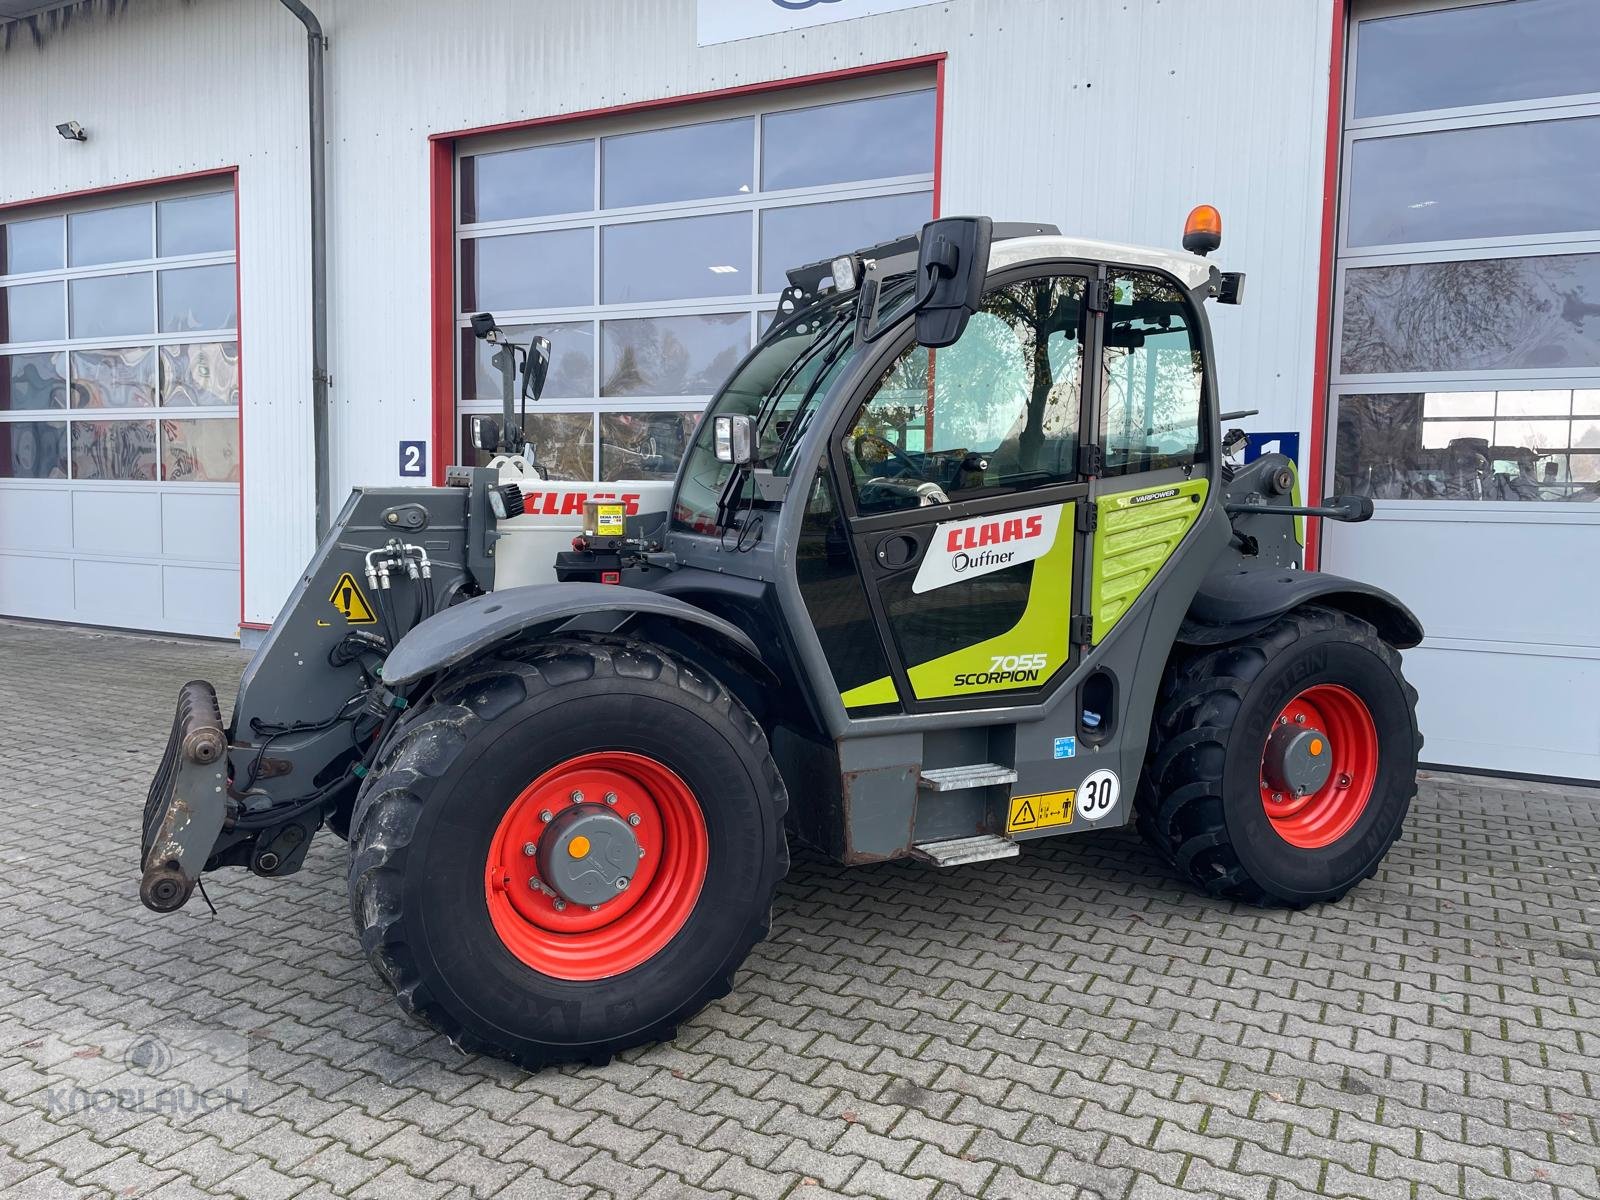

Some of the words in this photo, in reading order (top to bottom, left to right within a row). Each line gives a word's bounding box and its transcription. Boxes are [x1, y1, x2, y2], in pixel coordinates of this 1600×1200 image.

[404, 445, 420, 472] 2
[522, 491, 641, 517] CLAS
[1135, 489, 1175, 504] VARIPOWER
[946, 514, 1043, 553] CLAAS
[952, 550, 1015, 573] Duffner
[988, 653, 1048, 673] 7055
[953, 669, 1040, 687] SCORPION
[1083, 777, 1113, 813] 30
